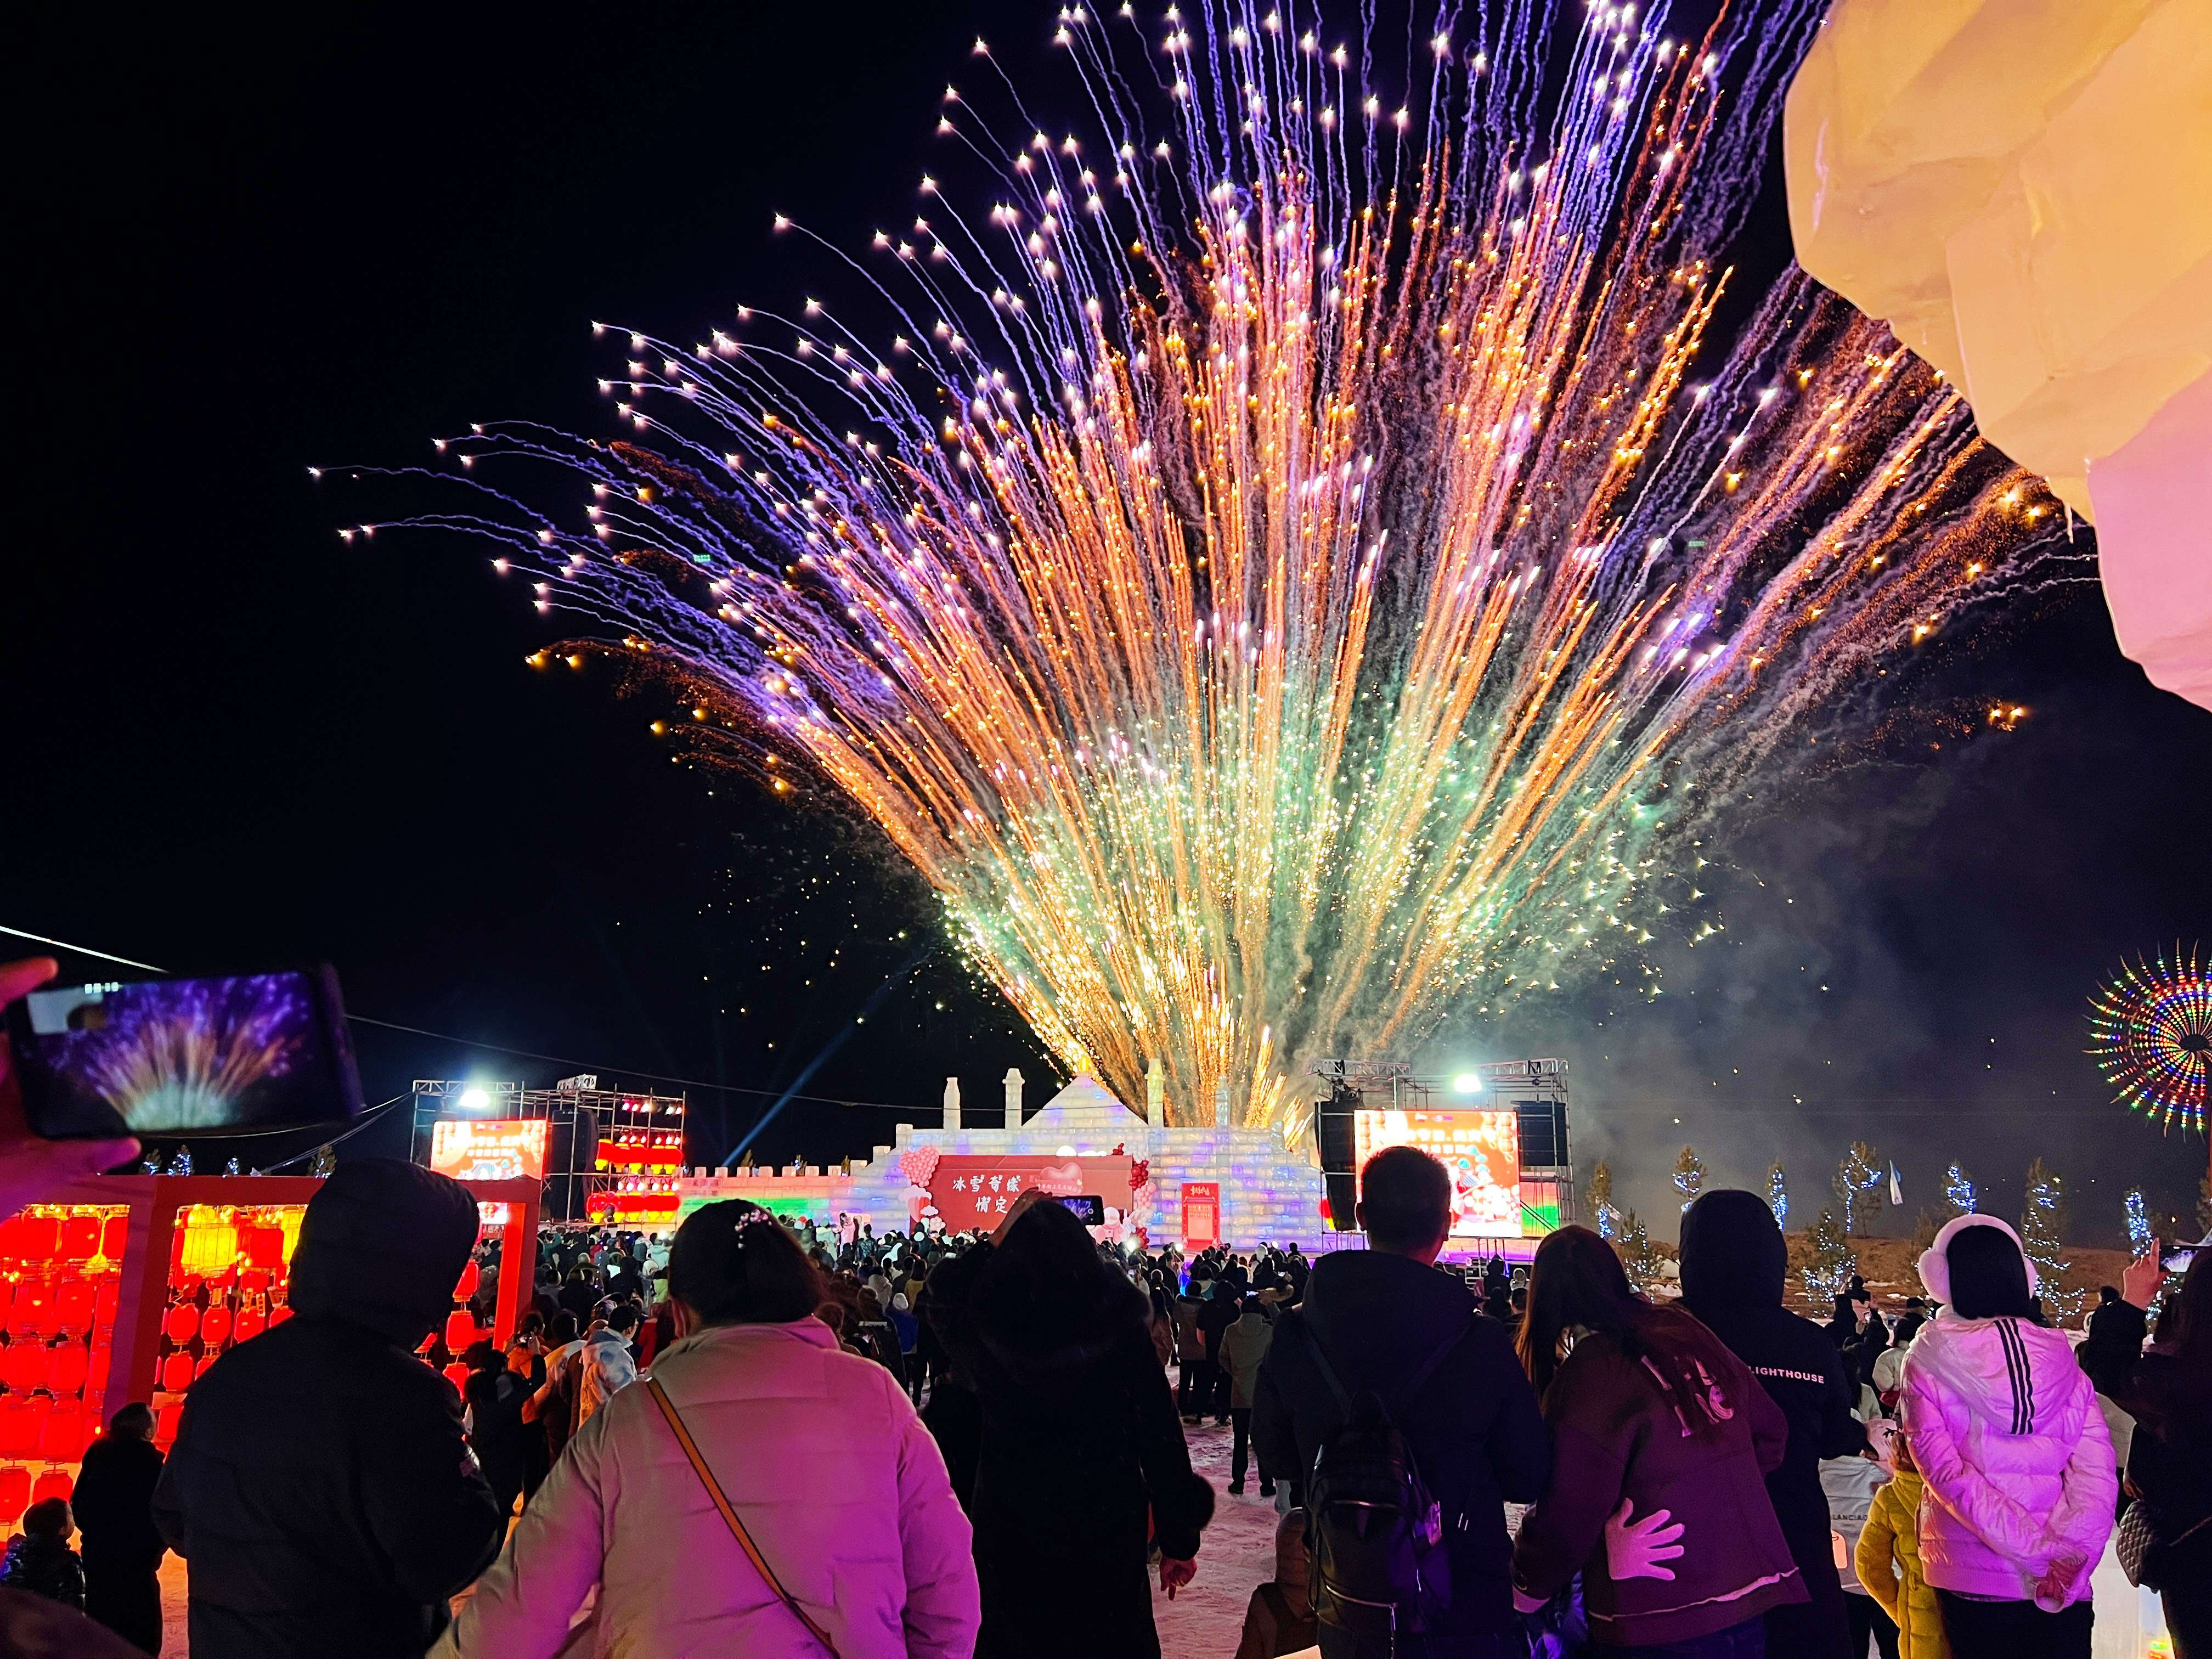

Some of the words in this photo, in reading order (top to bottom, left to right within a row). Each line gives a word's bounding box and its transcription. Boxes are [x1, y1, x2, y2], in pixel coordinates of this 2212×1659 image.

[952, 1175, 1021, 1193] 冰雪奇缘
[975, 1195, 1019, 1214] 情定
